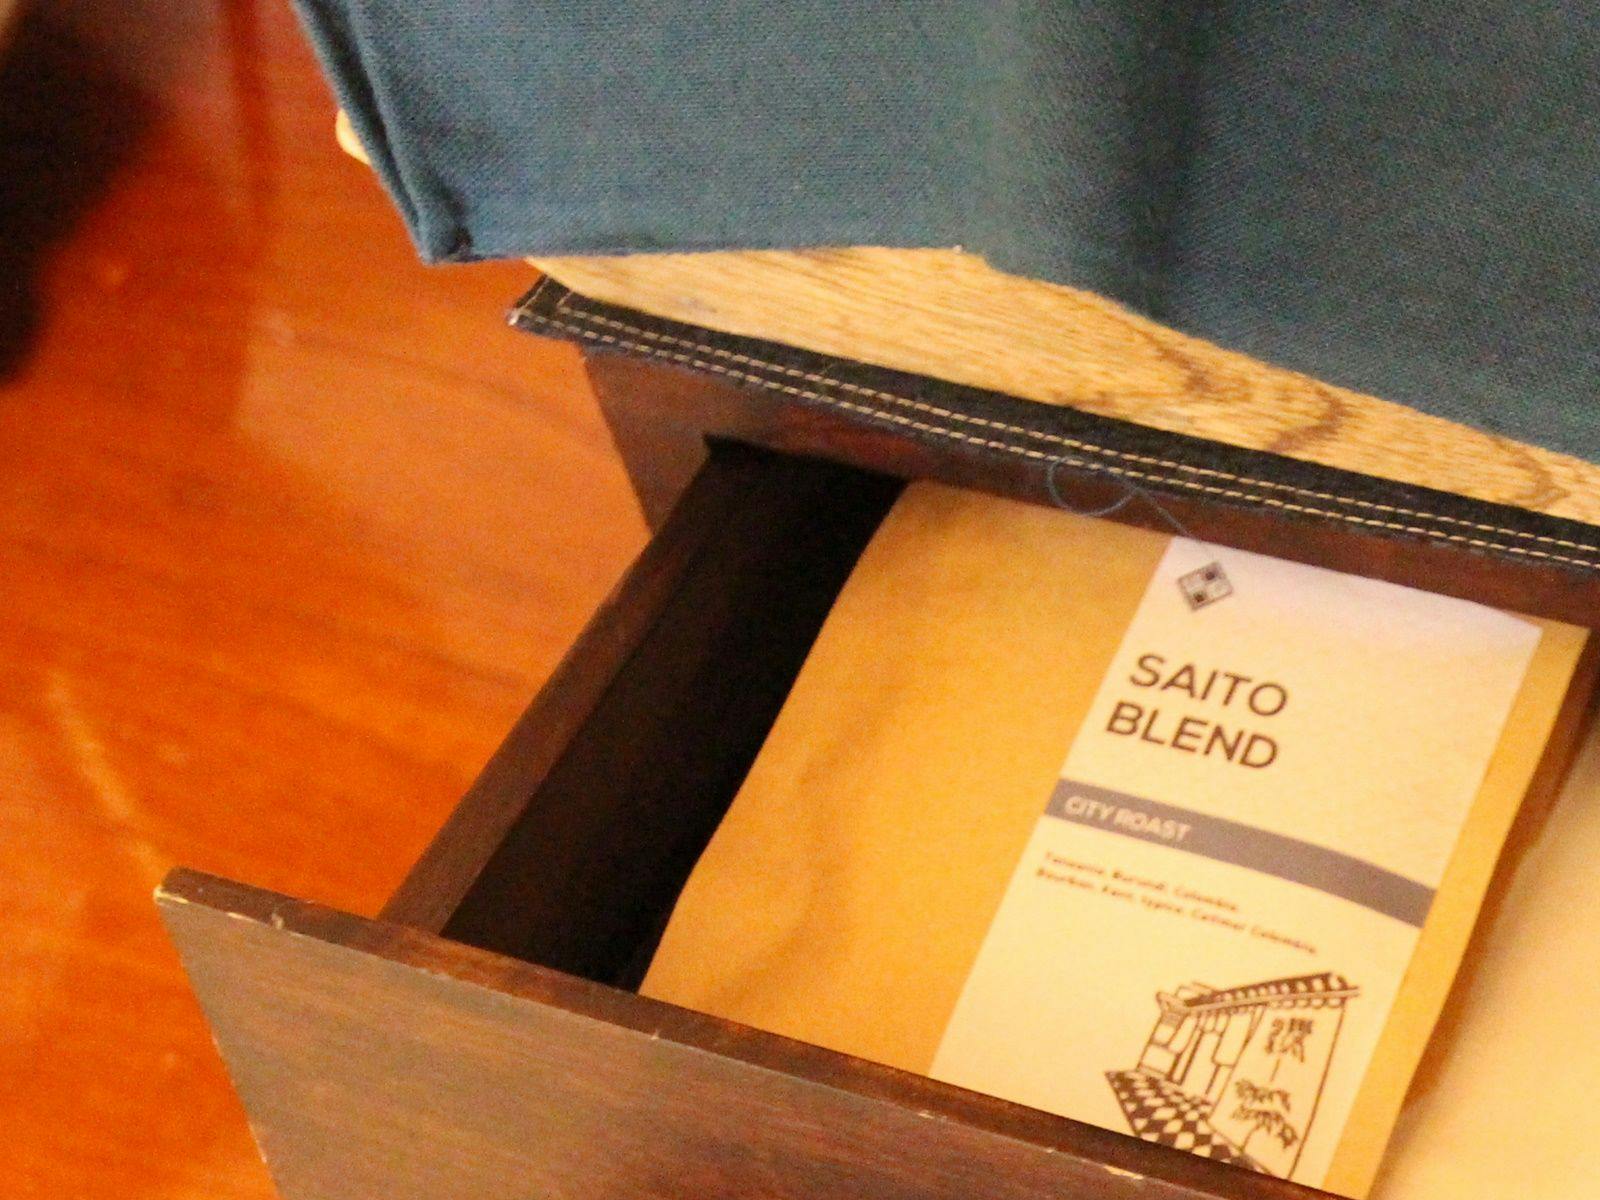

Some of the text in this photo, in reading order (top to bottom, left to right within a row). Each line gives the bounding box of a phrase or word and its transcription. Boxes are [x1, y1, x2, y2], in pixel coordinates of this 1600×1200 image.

[1129, 652, 1289, 718] SAITO
[1105, 700, 1280, 770] BLEND
[1063, 795, 1193, 842] CITY ROAST
